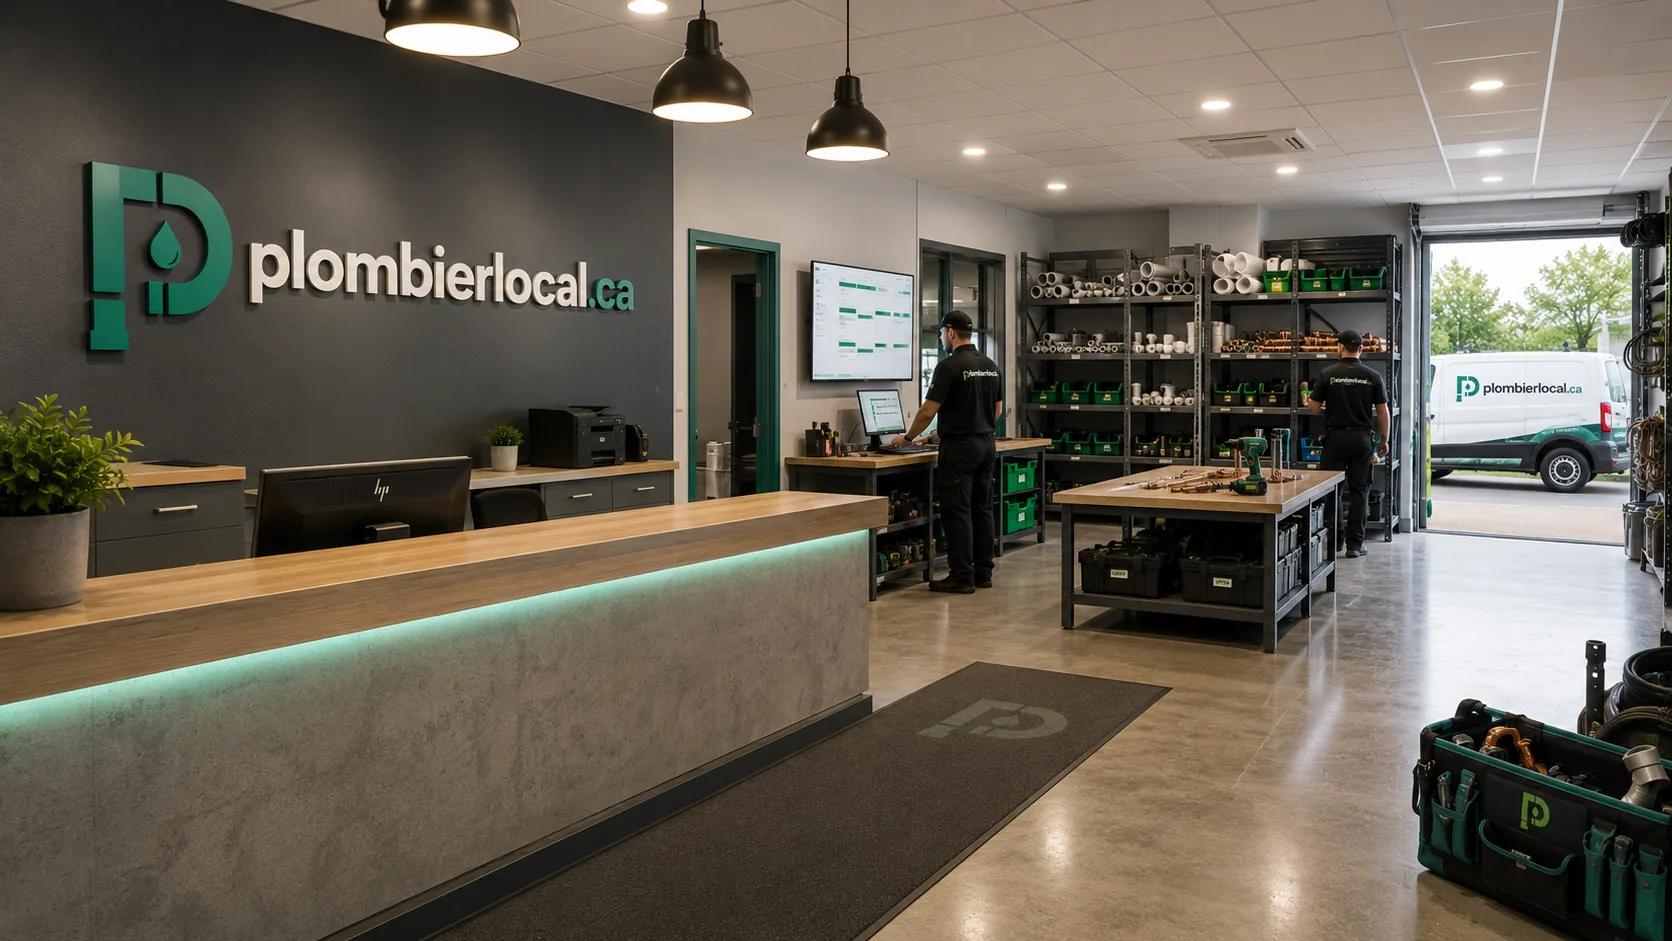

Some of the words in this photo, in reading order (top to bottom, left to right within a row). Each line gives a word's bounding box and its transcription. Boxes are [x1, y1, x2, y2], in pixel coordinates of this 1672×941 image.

[249, 229, 634, 310] plombierlocal.ca
[1483, 382, 1583, 396] plombierlocal.ca
[374, 478, 390, 502] hp
